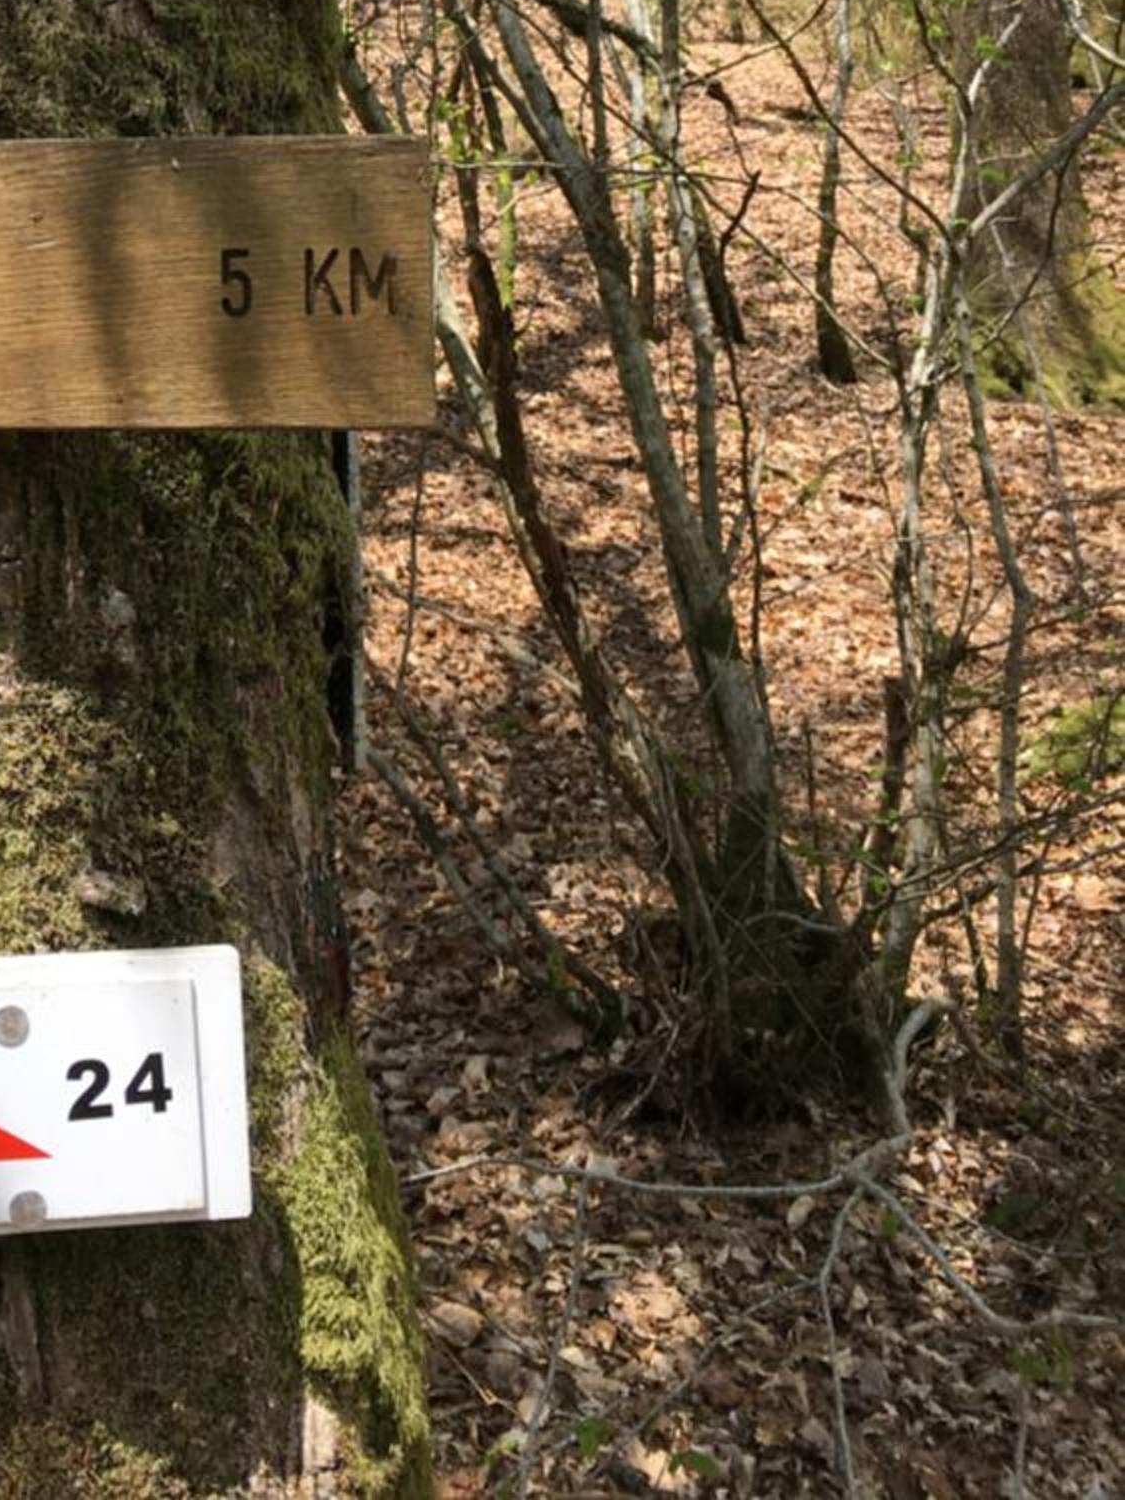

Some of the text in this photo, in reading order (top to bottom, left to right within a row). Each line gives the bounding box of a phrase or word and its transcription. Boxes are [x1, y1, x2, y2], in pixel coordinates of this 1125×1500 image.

[220, 247, 252, 318] 5
[303, 246, 399, 316] KM
[65, 1051, 173, 1122] 24
